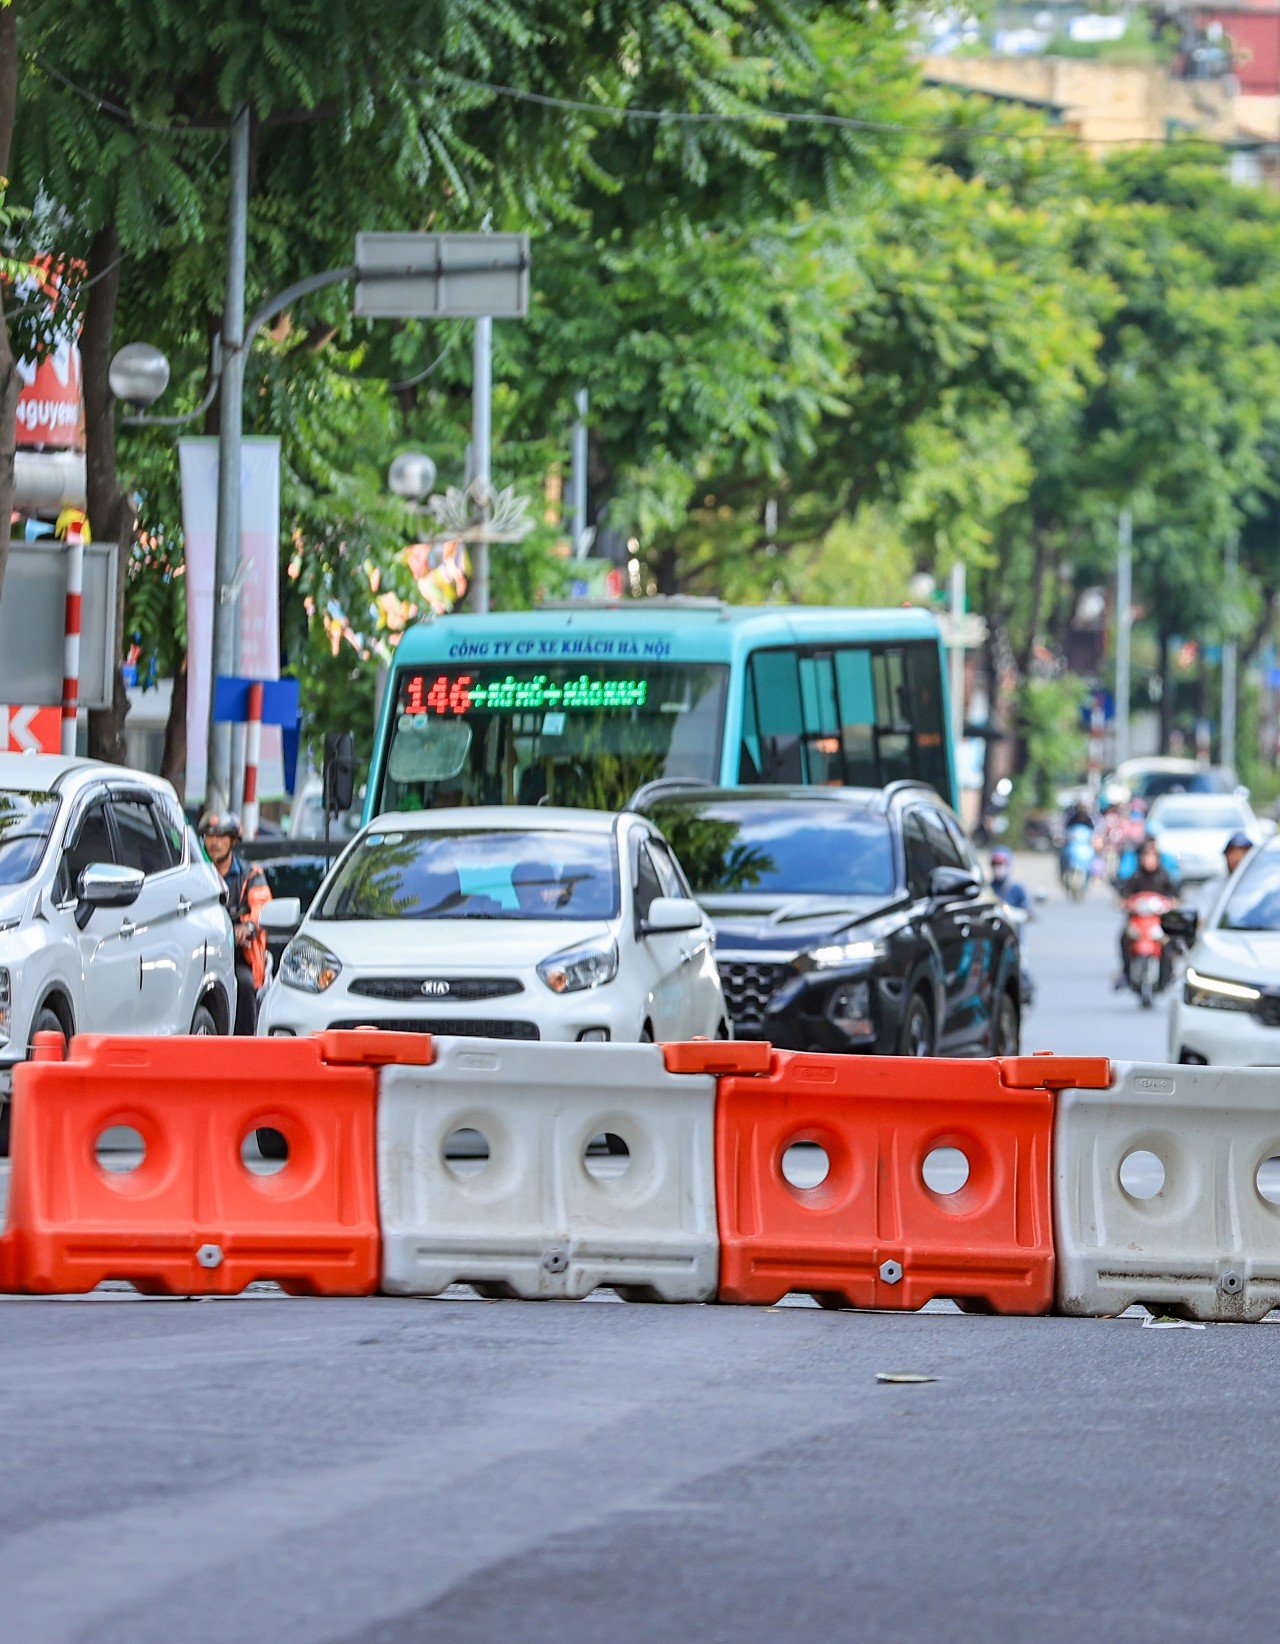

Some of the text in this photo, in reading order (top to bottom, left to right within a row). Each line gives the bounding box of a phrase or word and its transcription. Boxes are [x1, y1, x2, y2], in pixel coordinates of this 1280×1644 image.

[449, 635, 671, 660] CÔNG TY CP XE KHÁCH HÀ NỘI
[406, 675, 472, 714] 146
[423, 981, 449, 995] KIA
